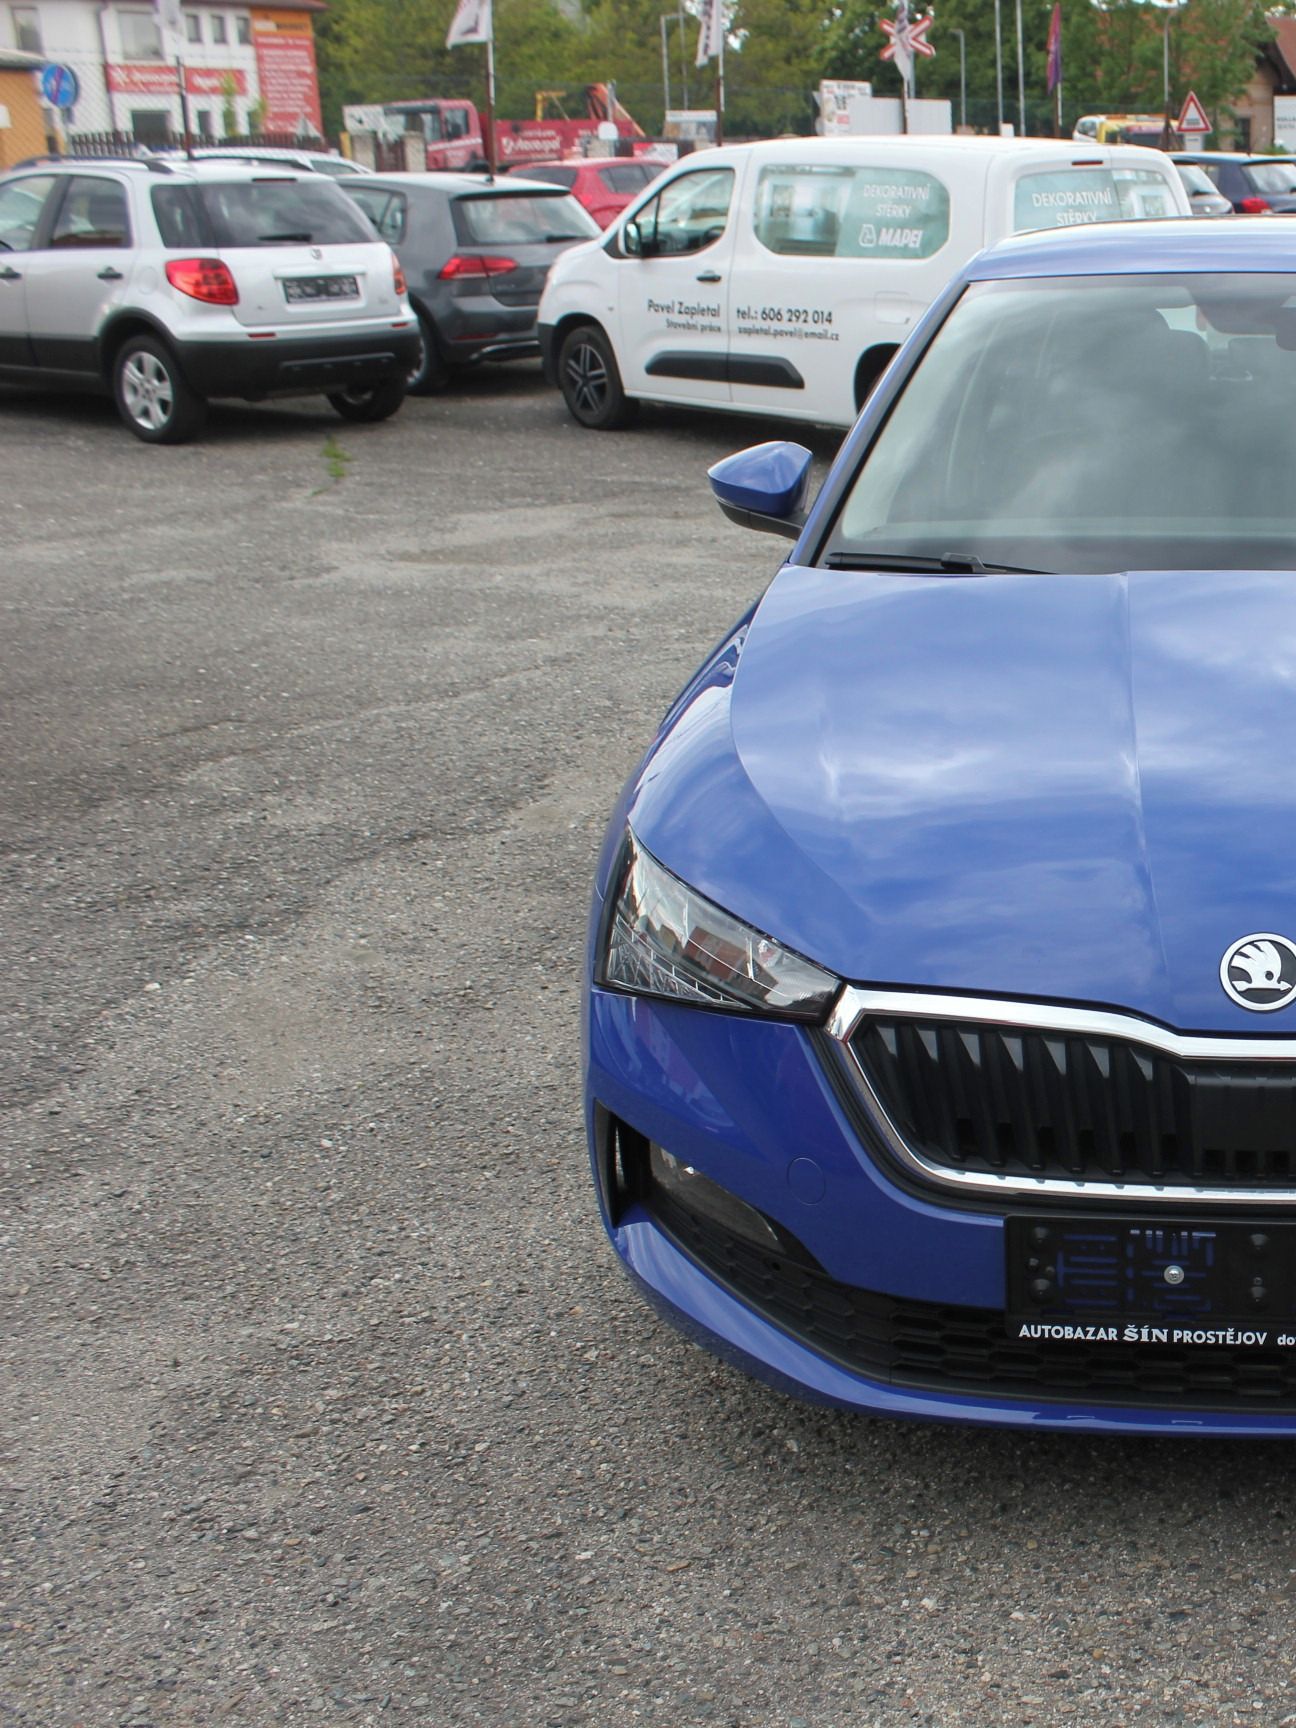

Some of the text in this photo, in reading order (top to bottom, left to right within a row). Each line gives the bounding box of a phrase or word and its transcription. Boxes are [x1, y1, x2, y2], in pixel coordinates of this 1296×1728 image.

[863, 184, 931, 200] DEKORATIVNÍ
[1031, 187, 1113, 207] DEKORATIVNÍ
[879, 227, 924, 248] MAPEI
[647, 299, 721, 319] Pavel Zapletal
[737, 305, 833, 325] tel.: 606 292 014
[1019, 1324, 1118, 1341] AUTOBAZAR
[1122, 1324, 1169, 1343] ŠÍN
[1173, 1328, 1268, 1345] PROSTĚJOV
